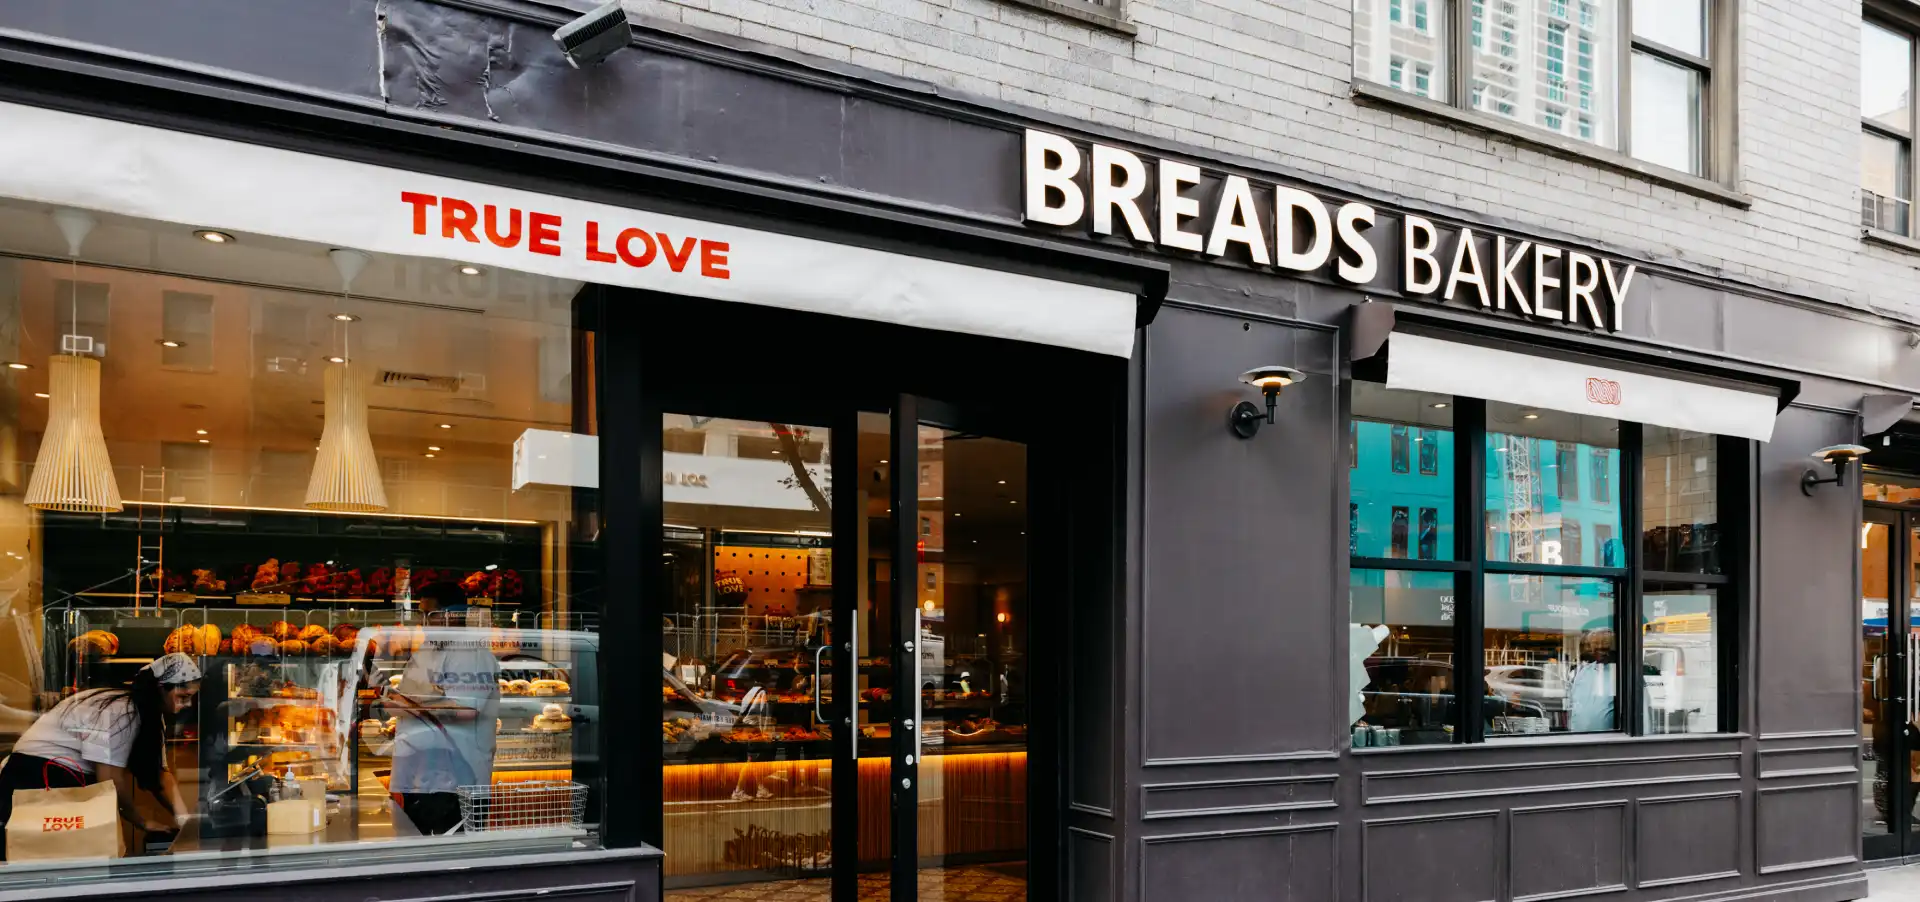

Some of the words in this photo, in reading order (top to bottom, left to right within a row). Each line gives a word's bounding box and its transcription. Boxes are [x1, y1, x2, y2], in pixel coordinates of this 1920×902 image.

[401, 191, 563, 257] TRUE
[585, 220, 731, 280] LOVE
[1023, 128, 1379, 286] BREADS
[1403, 213, 1636, 332] BAKERY
[714, 575, 742, 588] TRUE
[715, 581, 743, 595] LOVE
[44, 815, 84, 824] TRUE
[42, 823, 84, 833] LOVE
